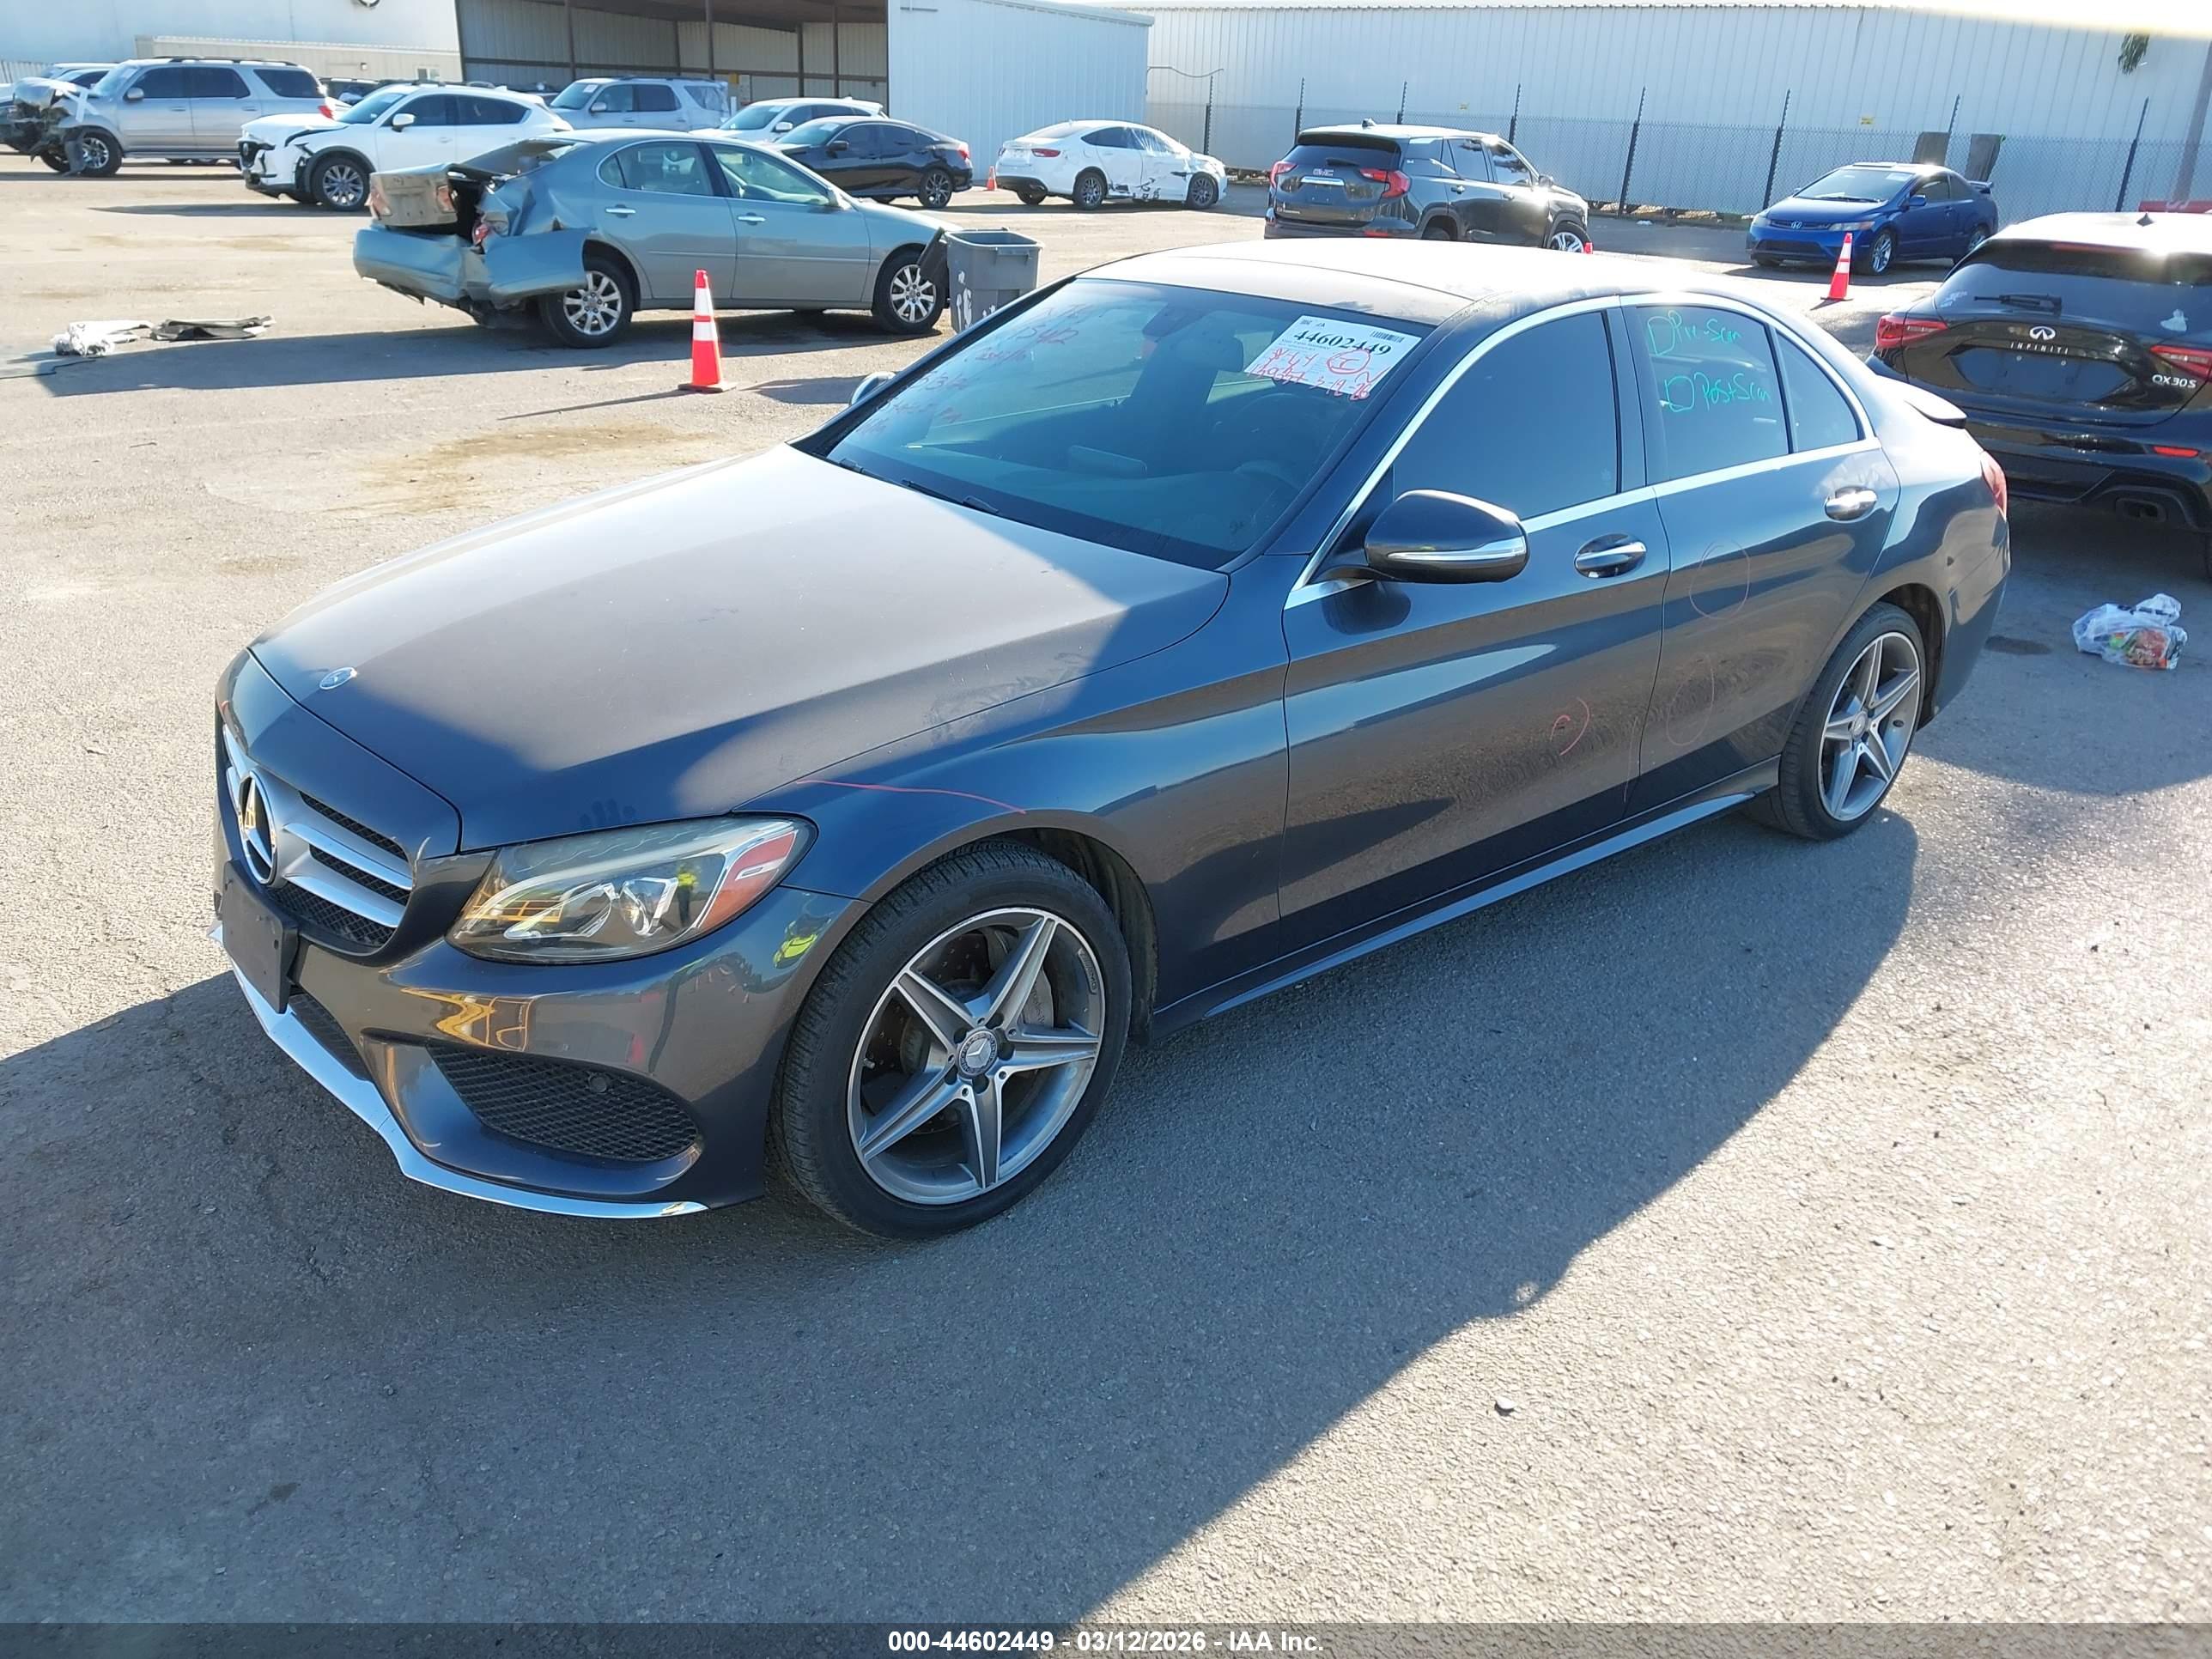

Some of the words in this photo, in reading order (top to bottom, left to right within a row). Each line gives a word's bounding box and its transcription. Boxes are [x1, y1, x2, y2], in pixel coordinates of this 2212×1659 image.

[1293, 330, 1392, 355] 44602449
[2010, 342, 2069, 354] INFINITI
[2152, 374, 2197, 388] QX30S
